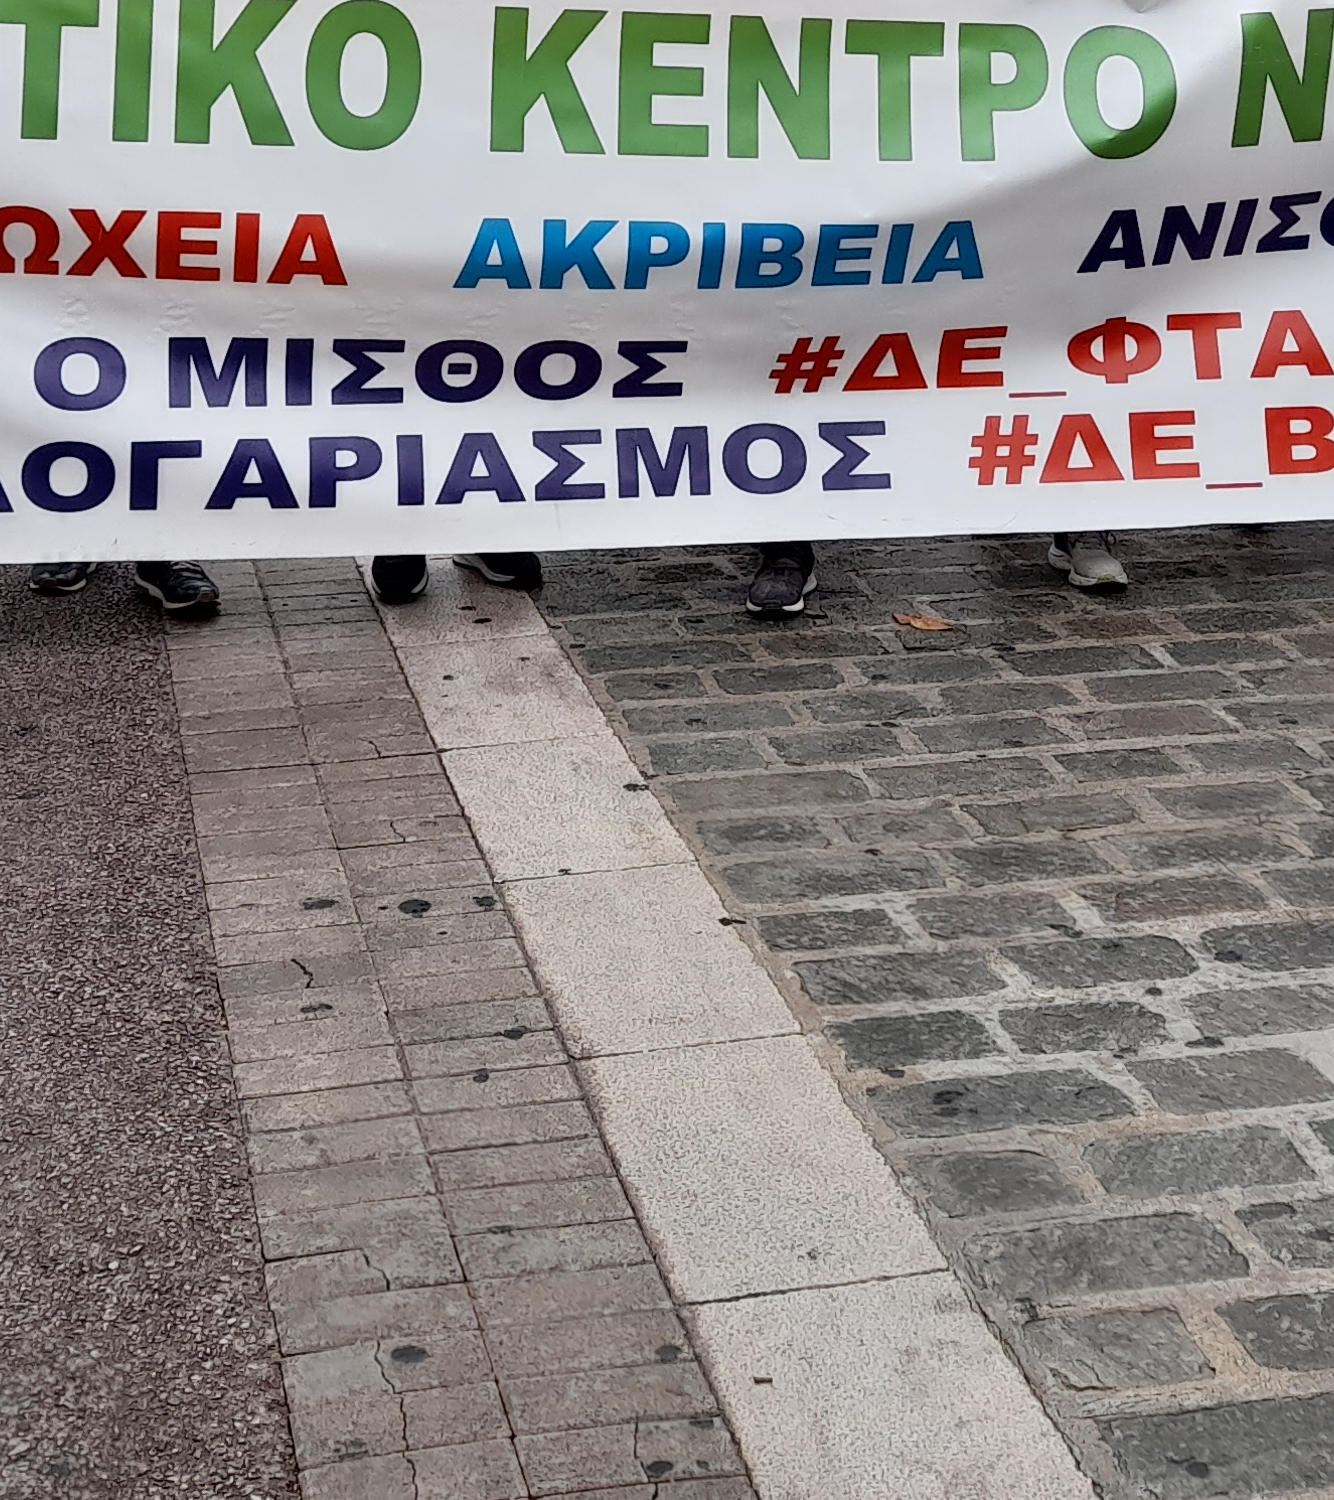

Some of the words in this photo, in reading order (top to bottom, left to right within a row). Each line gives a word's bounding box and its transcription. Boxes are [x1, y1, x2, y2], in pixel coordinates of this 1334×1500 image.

[491, 6, 1178, 161] ΚΕΝΤΡΟ
[453, 217, 985, 290] ΑΚΡΙΒΕΙΑ
[34, 337, 127, 411] Ο
[168, 337, 689, 408] ΜΙΣΘΟΣ
